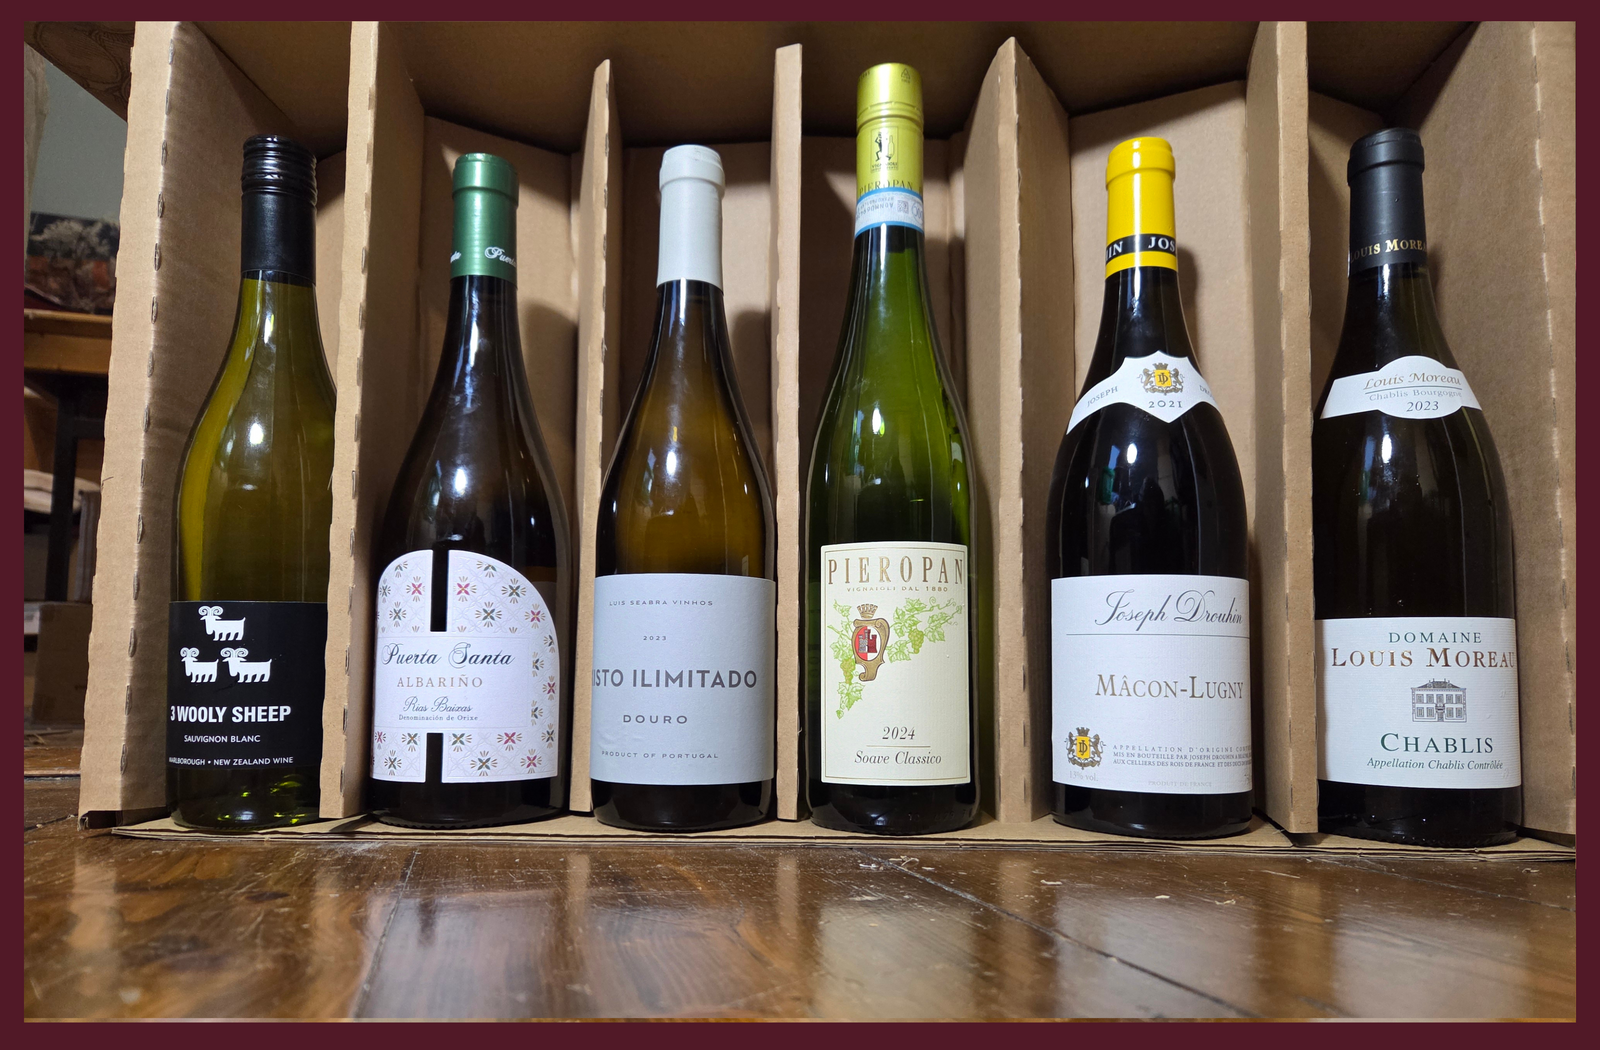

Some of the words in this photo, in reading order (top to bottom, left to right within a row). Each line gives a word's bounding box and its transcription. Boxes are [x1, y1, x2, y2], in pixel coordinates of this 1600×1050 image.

[1350, 243, 1381, 263] LOUIS
[1363, 374, 1404, 390] Louis
[1408, 372, 1462, 386] Moreau
[1086, 386, 1118, 408] JOSEPH
[1369, 390, 1408, 401] Chablis
[1412, 389, 1462, 398] Bourgogne
[1148, 400, 1182, 408] 2021
[1406, 400, 1439, 412] 2023
[828, 555, 963, 584] PIEROPAN
[1094, 589, 1172, 632] Joseph
[1173, 590, 1243, 624] Drouhin
[1389, 632, 1482, 644] DOMAINE
[381, 642, 442, 666] Puerta
[448, 642, 516, 669] Santa
[1332, 648, 1413, 667] LOUIS
[1426, 648, 1516, 668] MOREAU
[397, 674, 483, 688] ALBARIÑO
[592, 669, 624, 688] ISTO
[632, 669, 757, 688] ILIMITADO
[431, 696, 473, 712] Baixas
[170, 706, 176, 722] 3
[176, 706, 228, 723] WOOLY
[231, 705, 292, 722] SHEEP
[622, 714, 688, 724] DOURO
[184, 735, 228, 744] SAUVIGNON
[230, 734, 261, 744] BLANC
[882, 726, 916, 740] 2024
[1380, 732, 1494, 754] CHABLIS
[213, 758, 231, 766] NEW
[232, 757, 271, 766] ZEALAND
[272, 756, 294, 764] WINE
[602, 750, 638, 758] PRODUCT
[854, 750, 890, 764] Soave
[894, 751, 942, 765] Classico
[1366, 758, 1425, 770] Appellation
[1428, 760, 1465, 770] Chablis
[1467, 760, 1504, 770] Contrôlée
[1085, 772, 1099, 782] vol.
